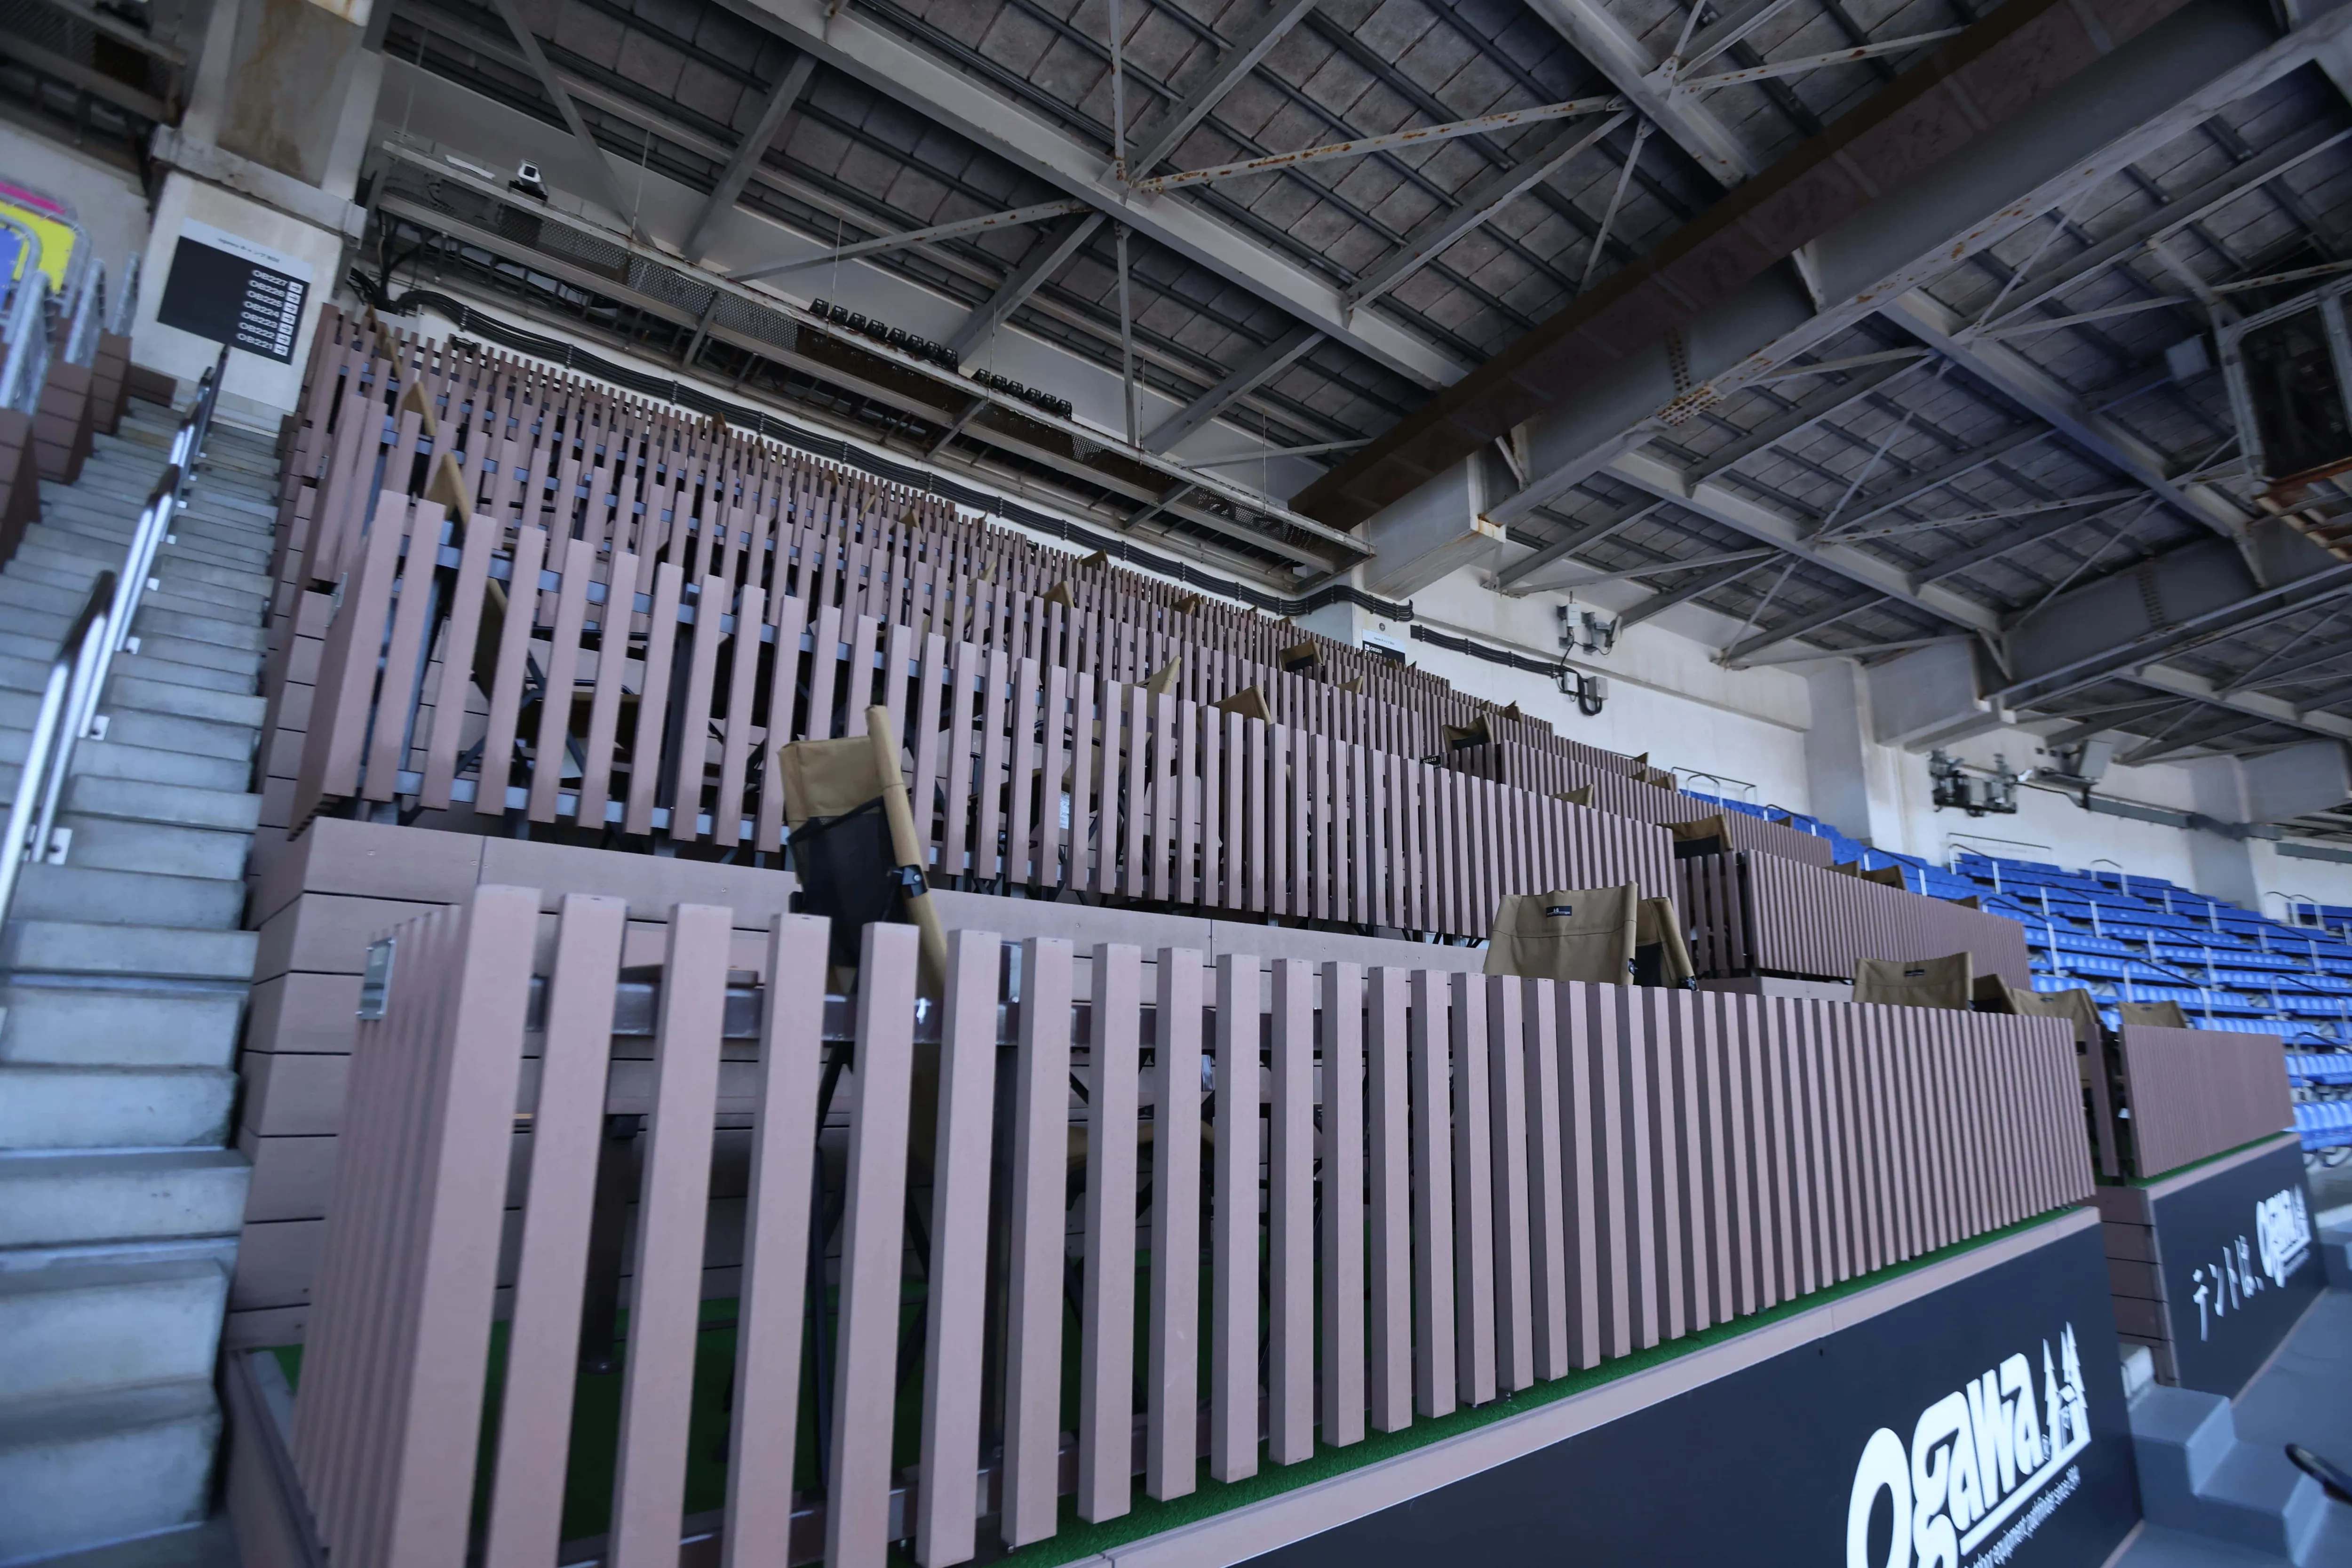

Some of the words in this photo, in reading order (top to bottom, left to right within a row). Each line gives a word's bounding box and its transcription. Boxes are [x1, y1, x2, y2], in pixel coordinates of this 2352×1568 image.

[252, 270, 288, 287] OB227
[248, 280, 286, 297] OB226
[246, 290, 283, 307] OB225
[243, 301, 279, 318] OB224
[240, 311, 278, 328] OB223
[238, 322, 276, 339] OB222
[236, 333, 273, 350] OB221
